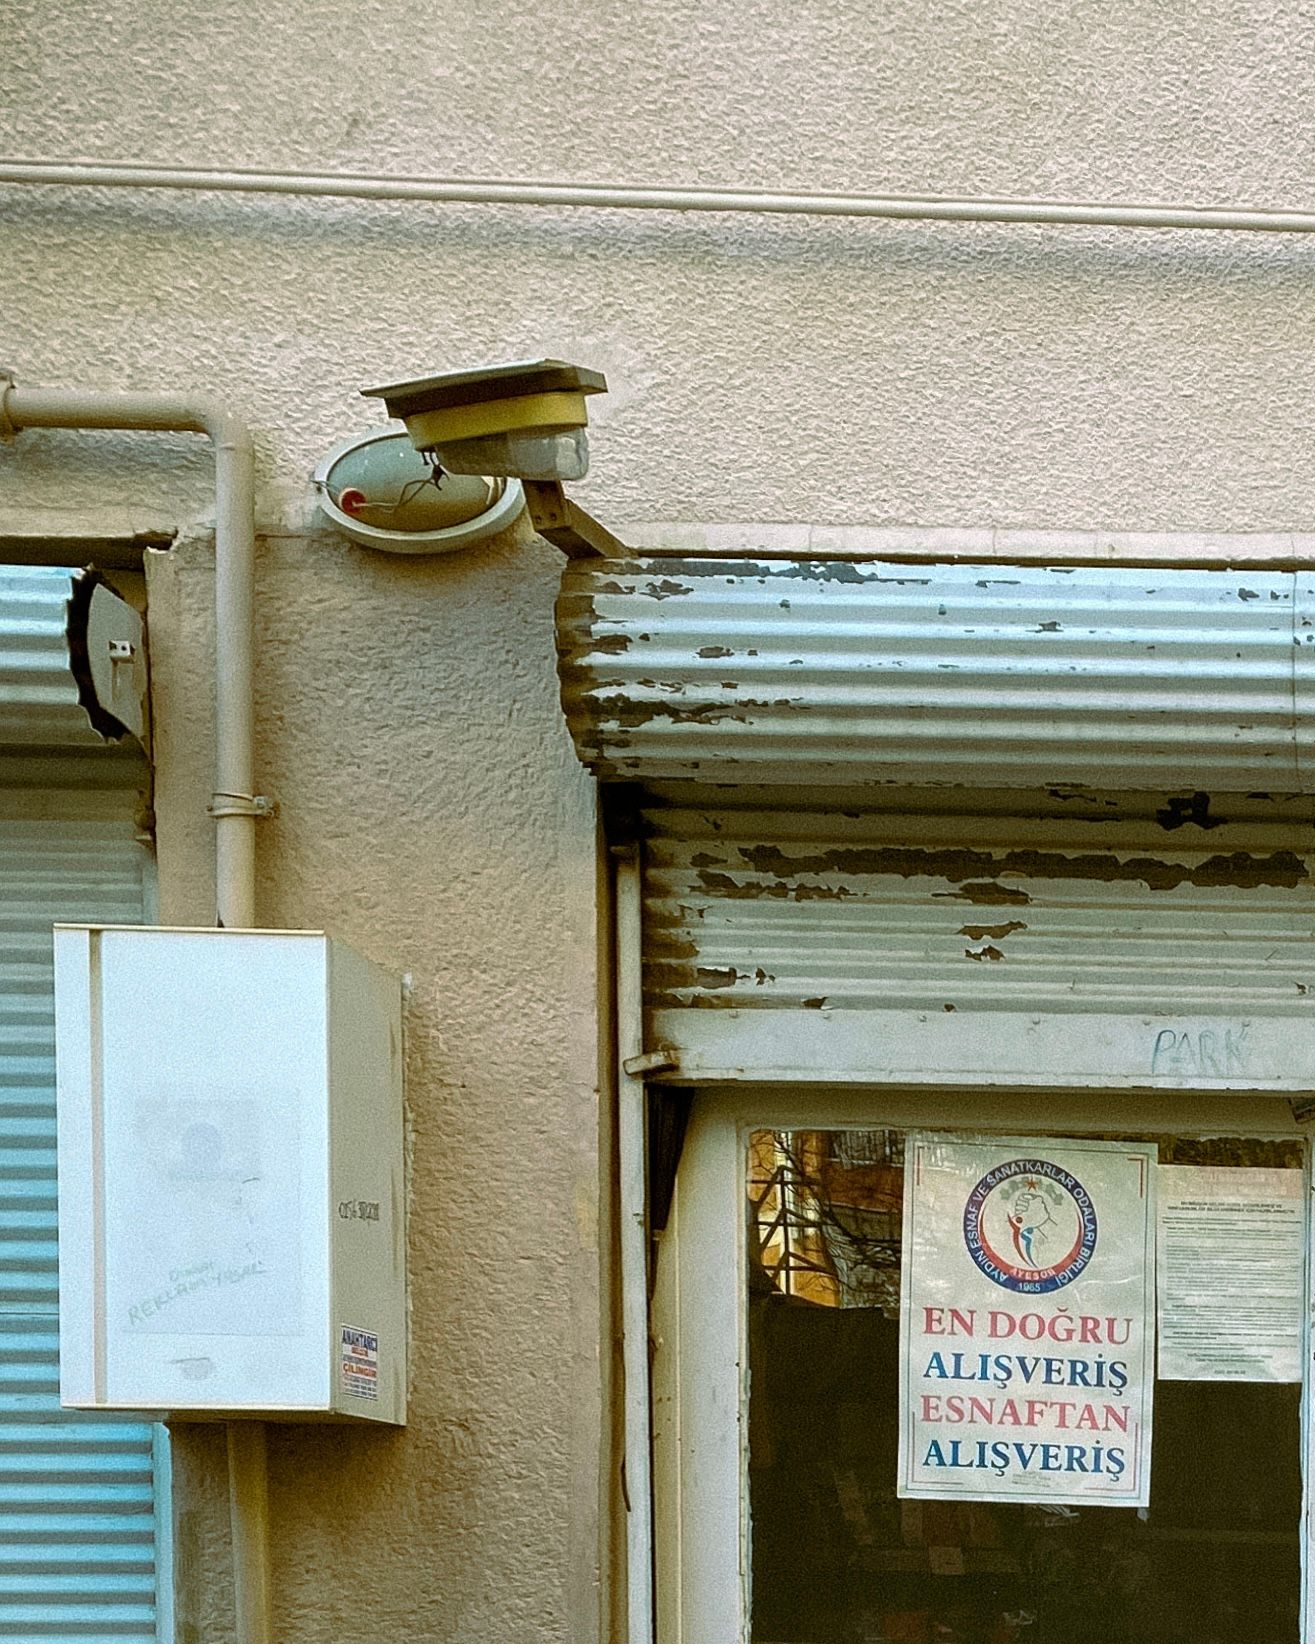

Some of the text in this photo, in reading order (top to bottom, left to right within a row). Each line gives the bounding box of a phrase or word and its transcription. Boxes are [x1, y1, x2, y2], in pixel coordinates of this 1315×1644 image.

[1151, 1027, 1246, 1076] PARK
[972, 1184, 989, 1201] VE
[967, 1205, 980, 1249] ESNAF
[974, 1251, 1008, 1281] AYDIN
[923, 1307, 977, 1337] EN
[988, 1307, 1133, 1345] DOĞRU
[923, 1351, 1128, 1396] ALIŞVERİŞ
[920, 1395, 1130, 1433] ESNAFTAN
[922, 1439, 1125, 1482] ALIŞVERİŞ
